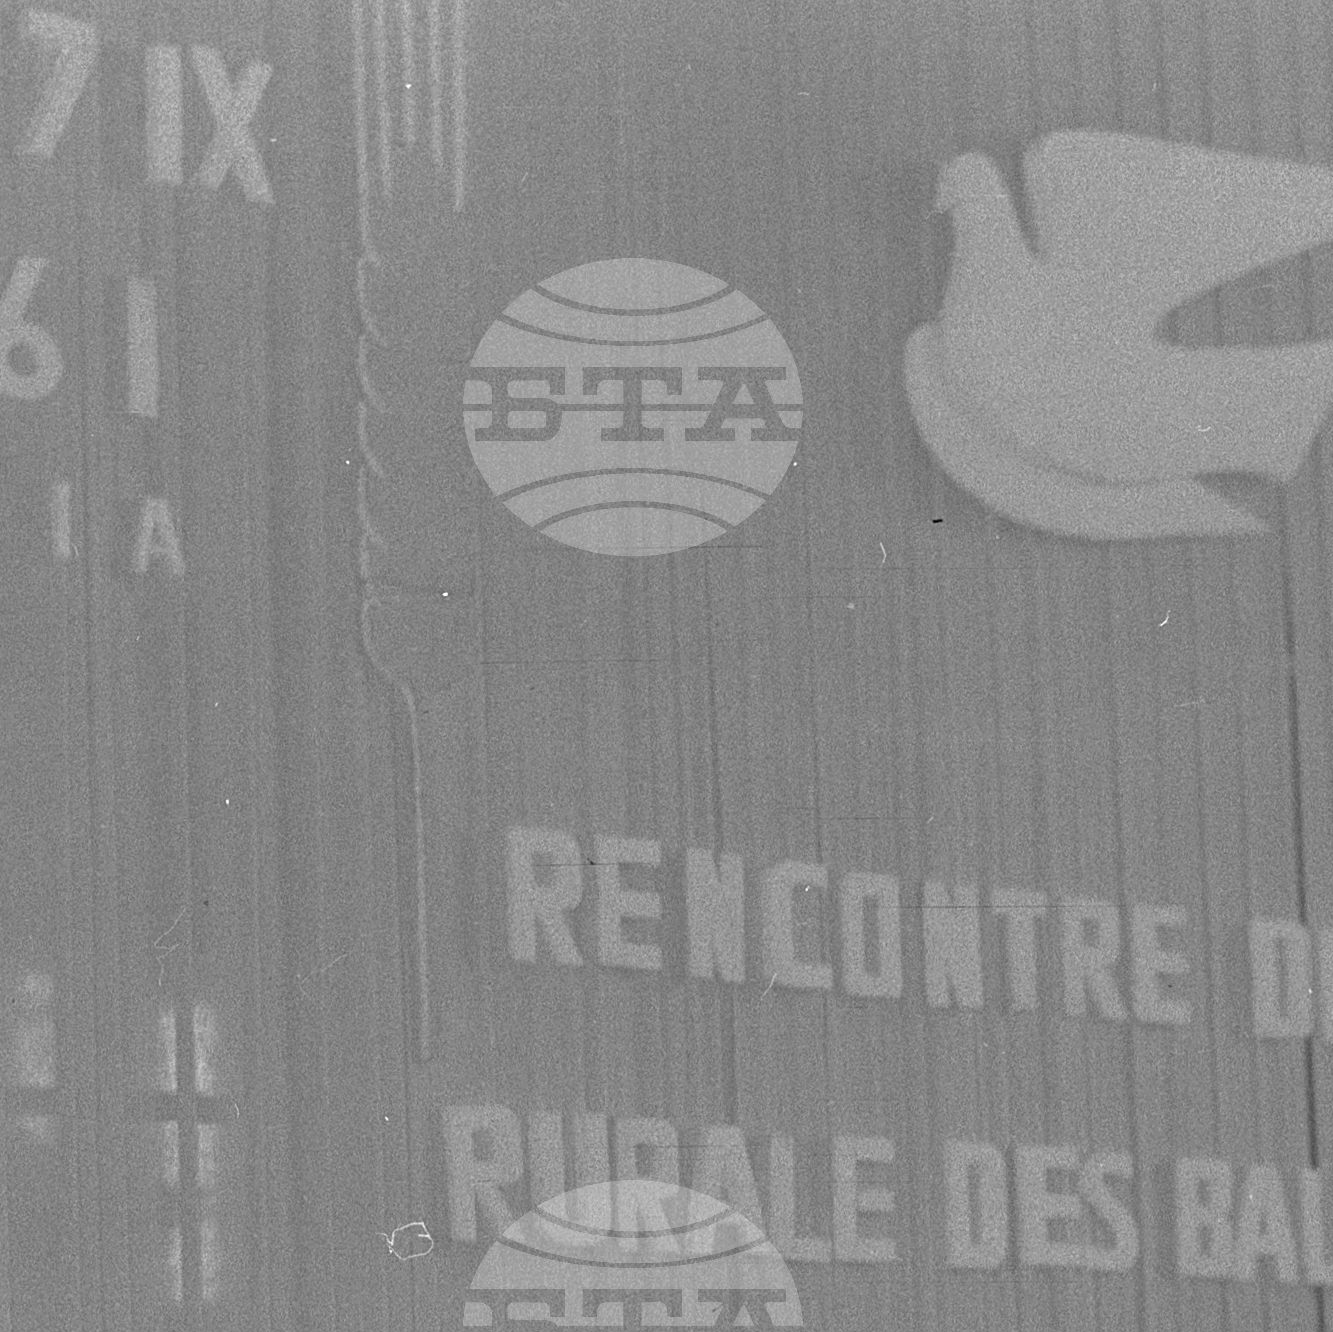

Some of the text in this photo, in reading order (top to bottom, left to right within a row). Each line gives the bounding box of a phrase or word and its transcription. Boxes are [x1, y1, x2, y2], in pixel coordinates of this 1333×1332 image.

[144, 42, 275, 205] IX
[506, 825, 1193, 1026] RENCONTRE
[944, 1138, 1141, 1274] DES
